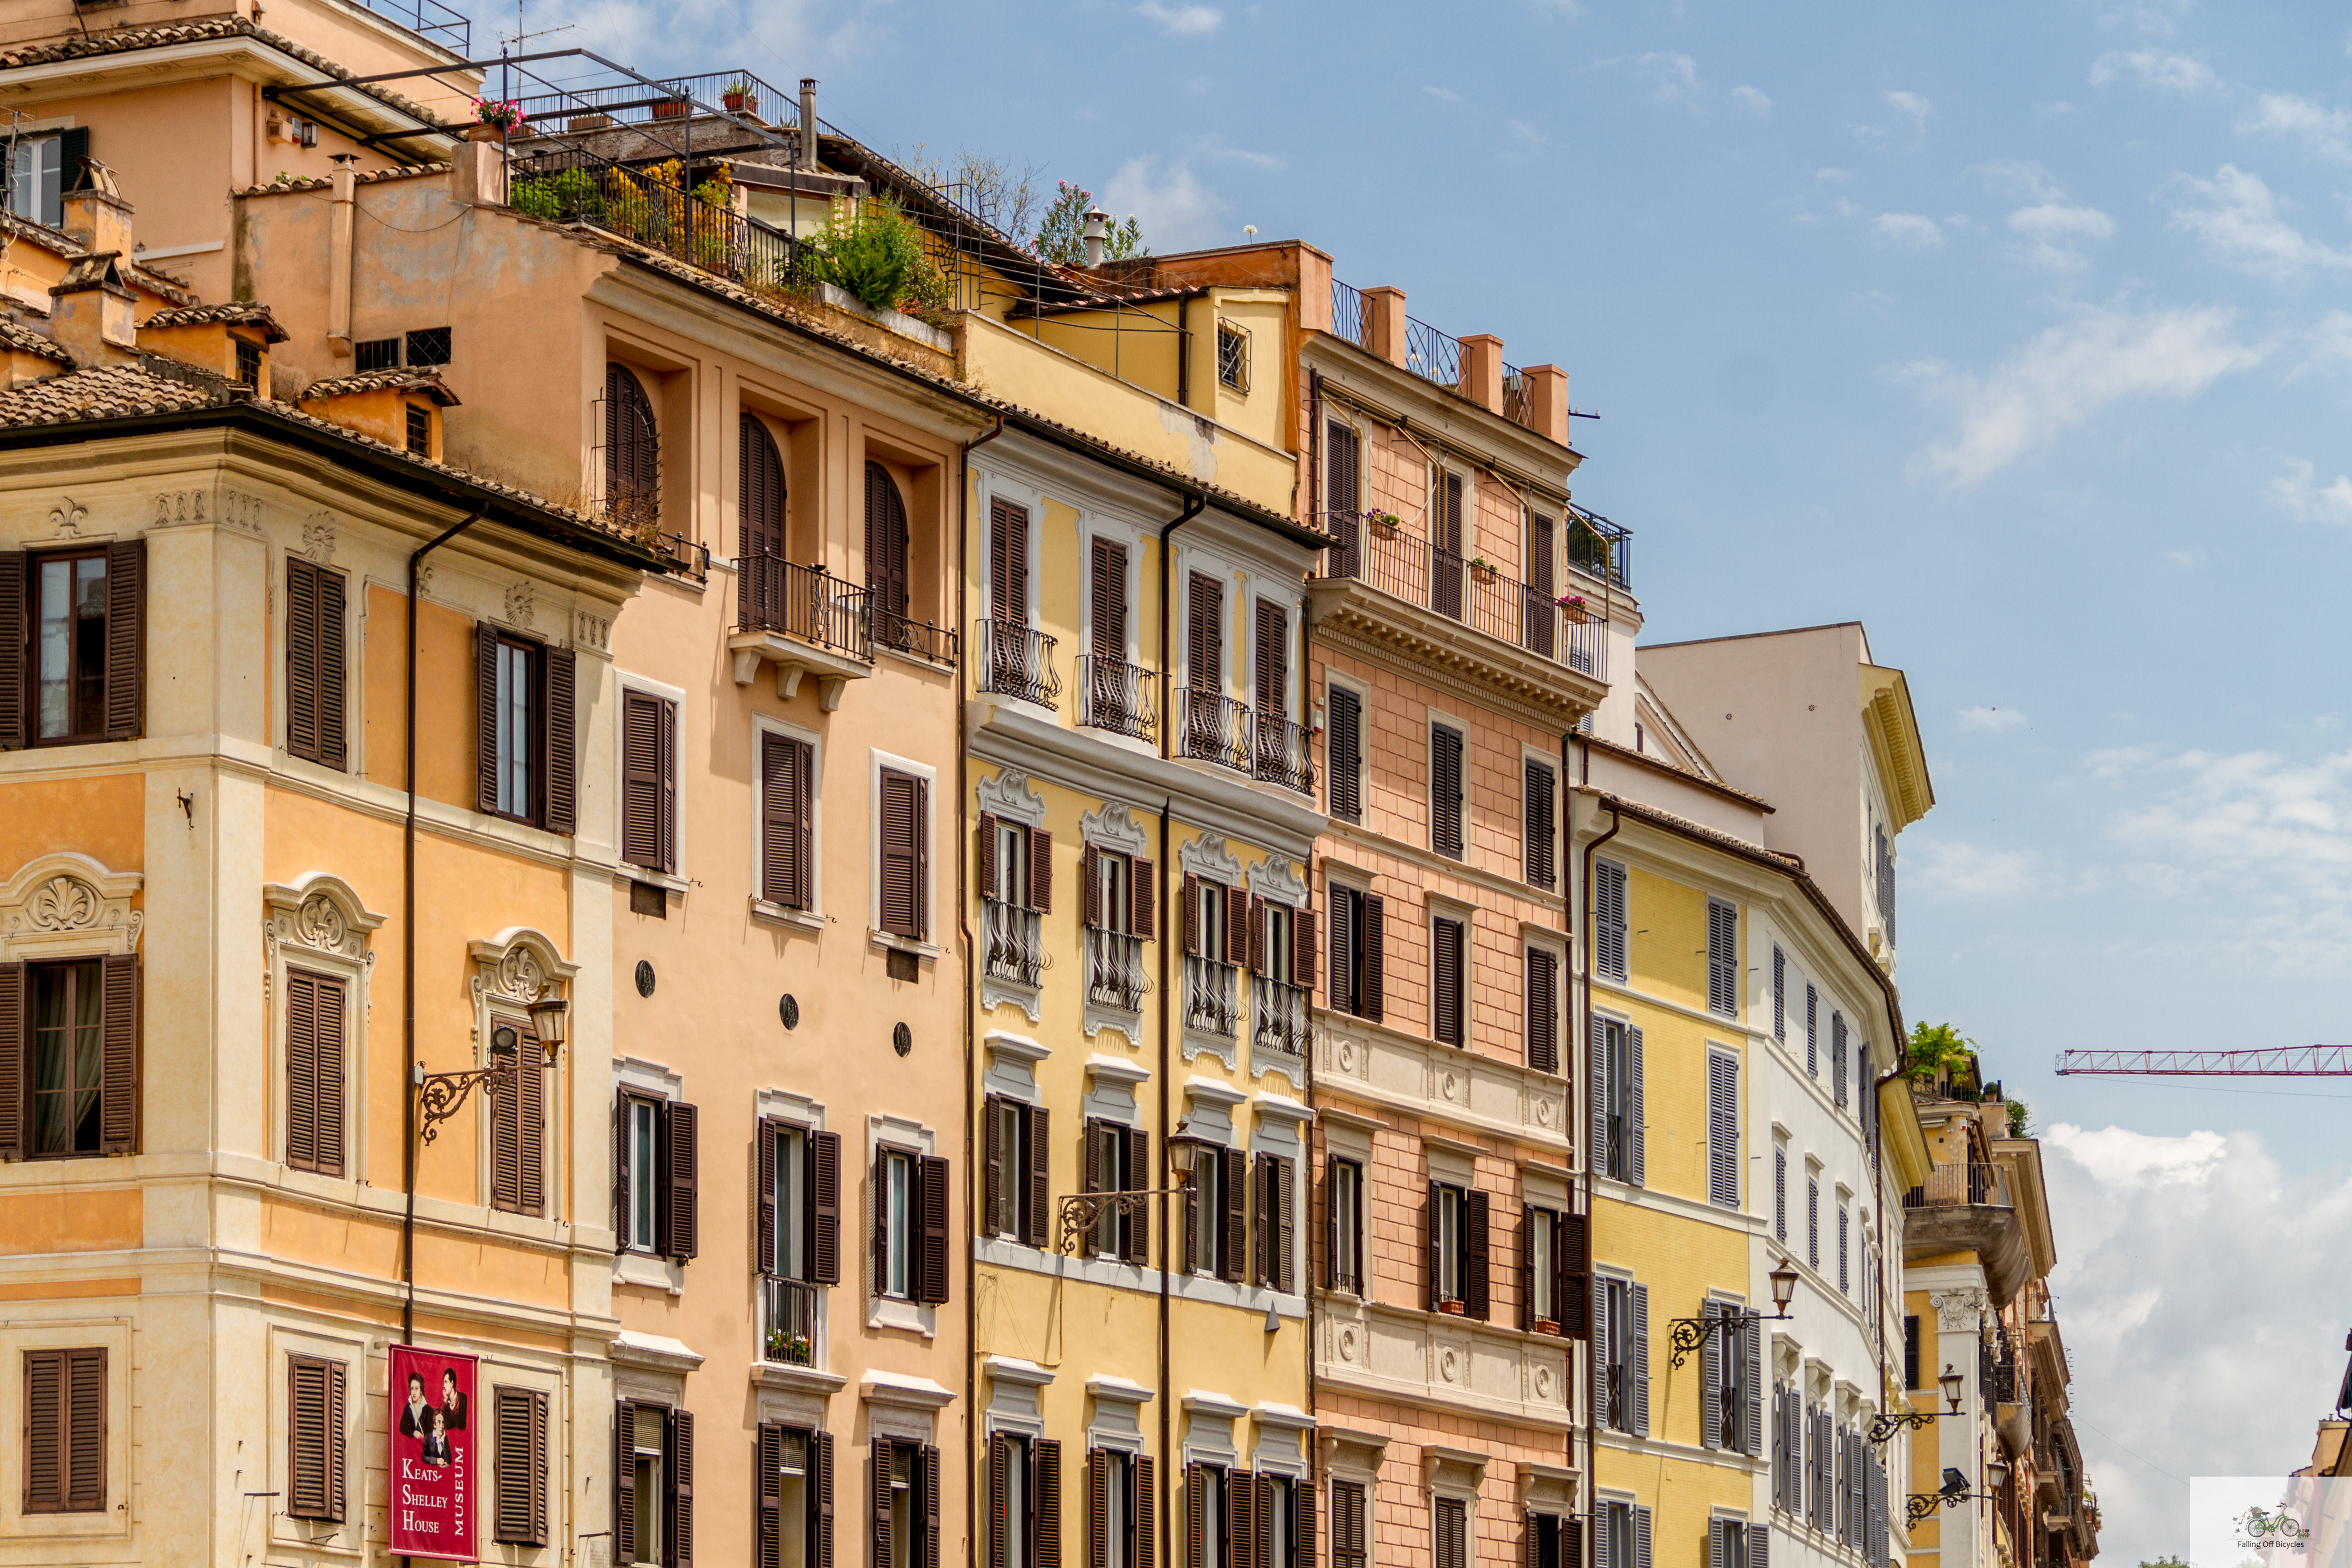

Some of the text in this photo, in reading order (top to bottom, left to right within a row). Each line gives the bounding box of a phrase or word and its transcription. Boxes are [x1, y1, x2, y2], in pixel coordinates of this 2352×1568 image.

[402, 1484, 448, 1508] SHELLEY
[455, 1447, 463, 1537] MUSEUM
[402, 1510, 439, 1533] HOUSE
